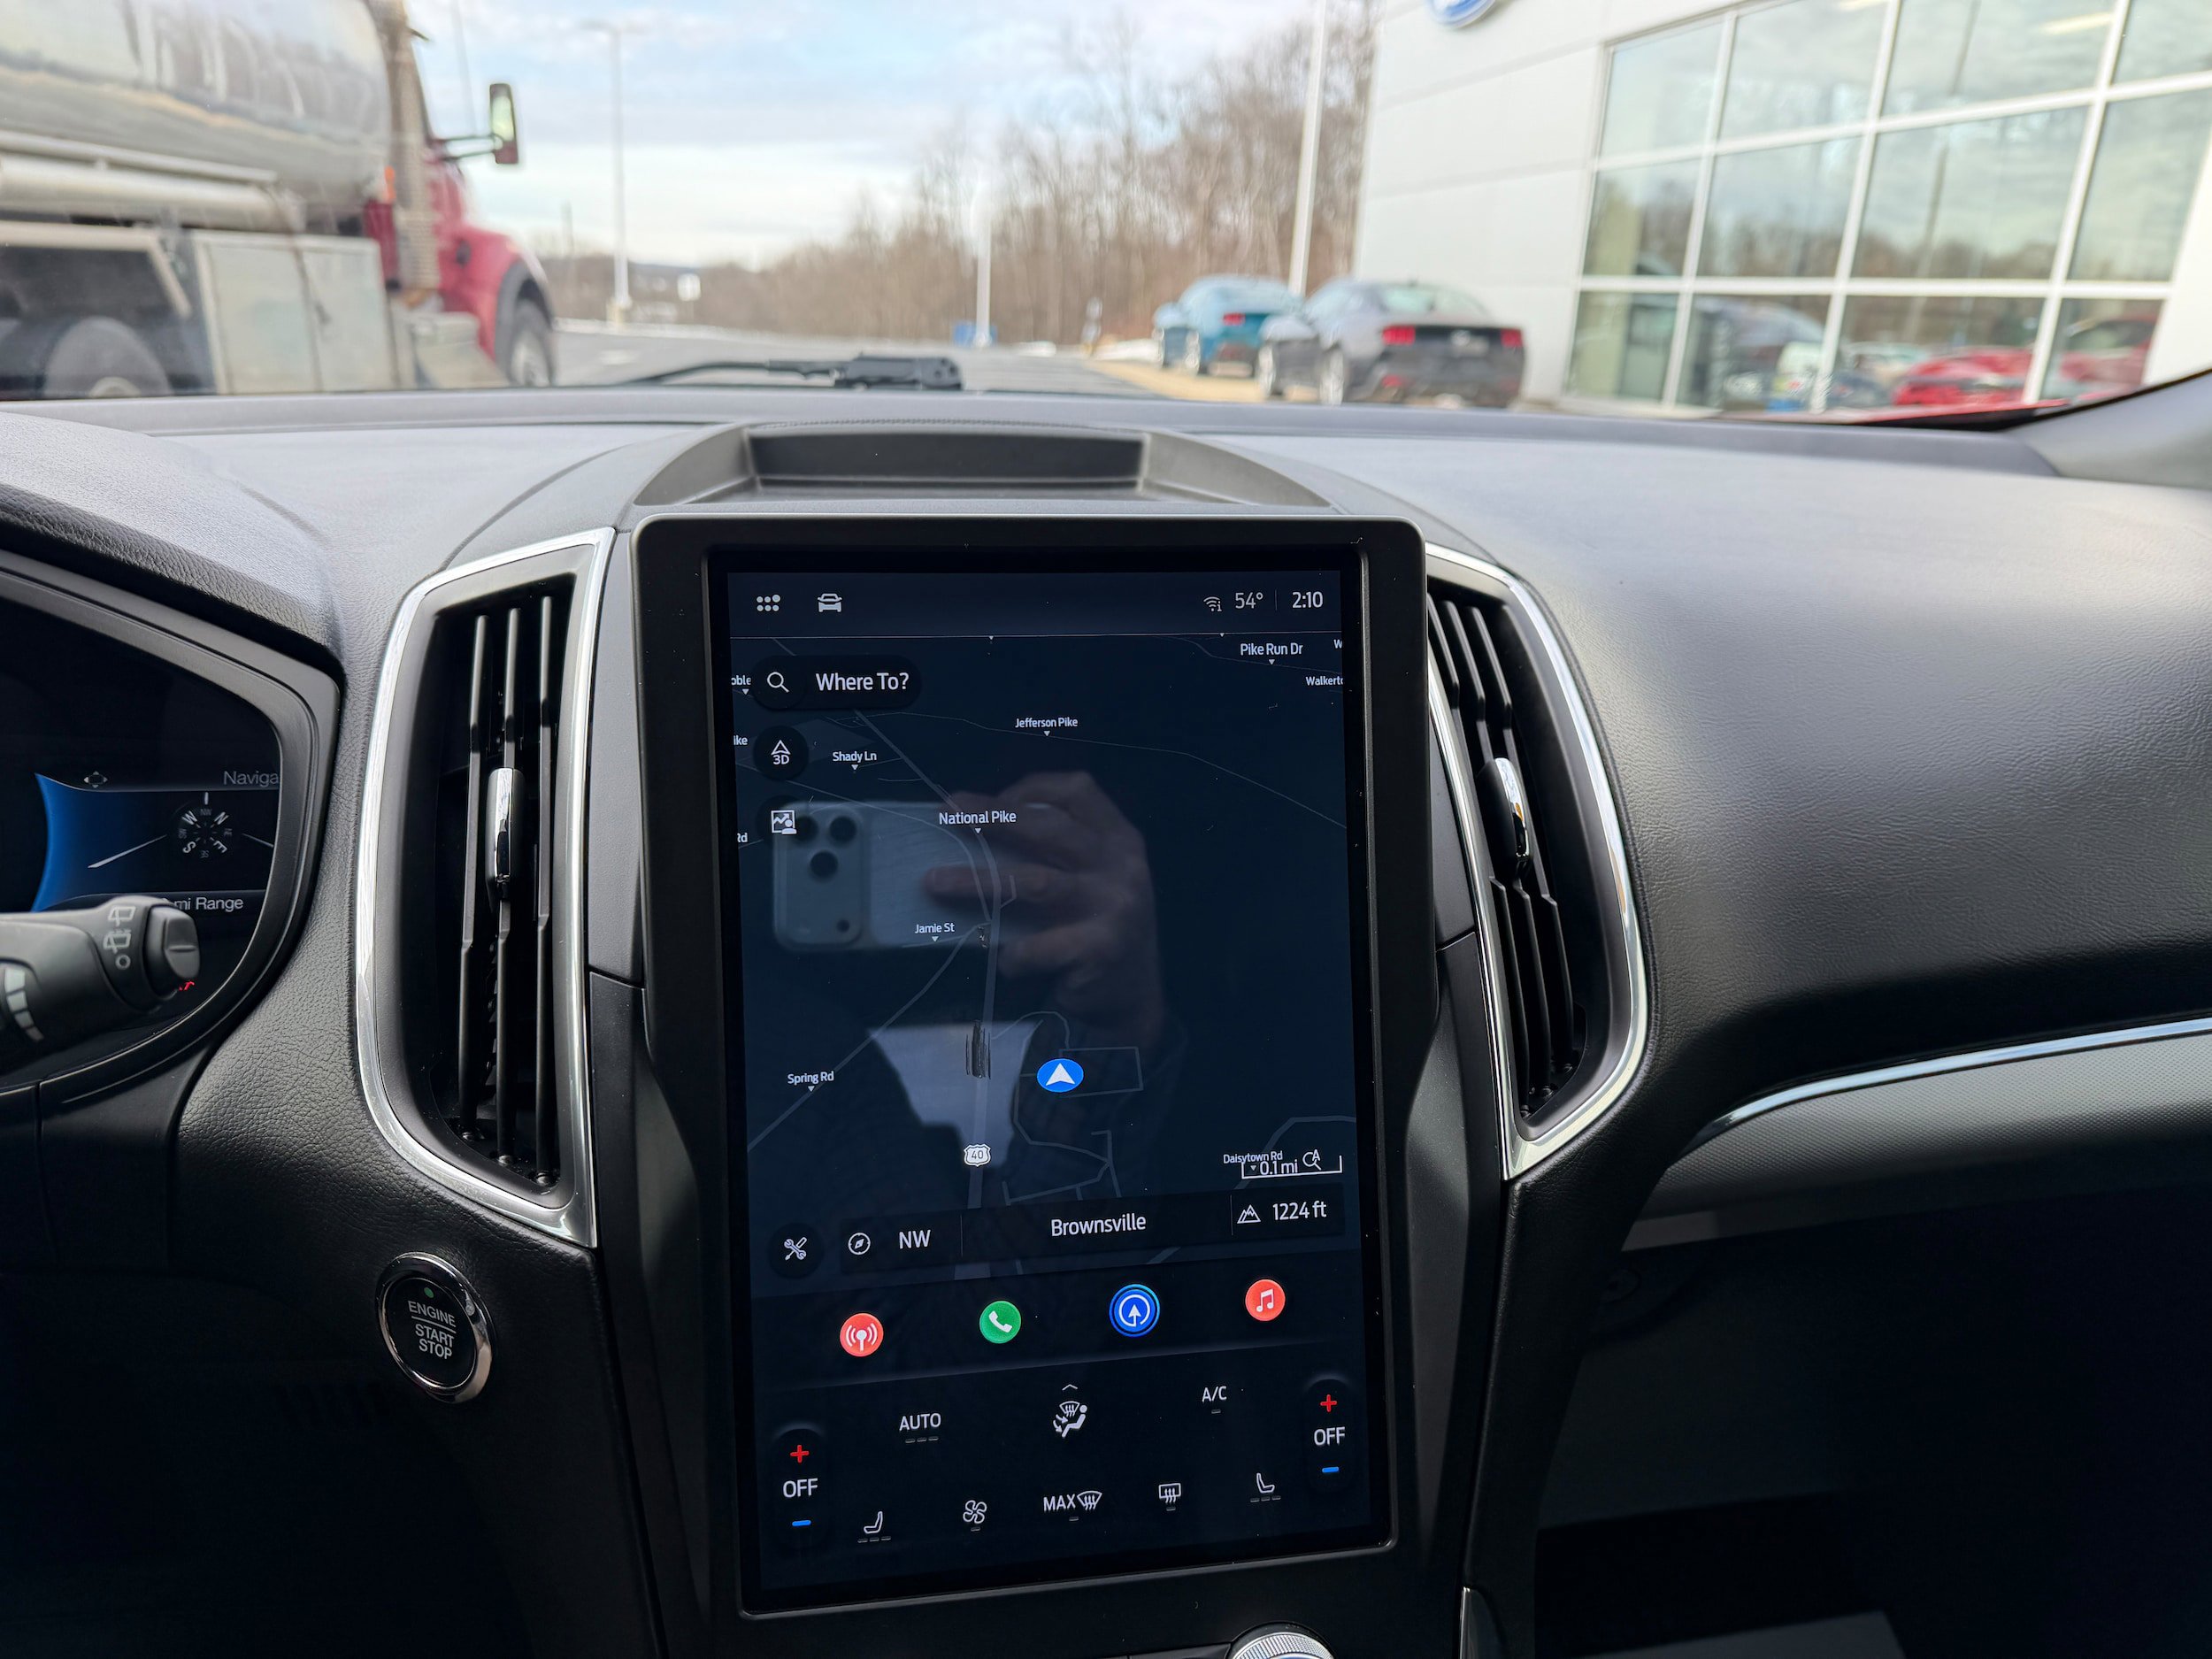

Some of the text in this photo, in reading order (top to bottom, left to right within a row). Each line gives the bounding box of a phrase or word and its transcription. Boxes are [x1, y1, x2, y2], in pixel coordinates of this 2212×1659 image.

[1234, 591, 1264, 610] 54°
[1291, 590, 1324, 609] 2:10
[1240, 642, 1303, 656] Pike Run Dr
[815, 672, 910, 691] Where To?
[1015, 717, 1079, 728] Jefferson Pike
[772, 755, 790, 765] 3D
[832, 751, 877, 764] Shady Ln
[223, 770, 280, 787] Naviga
[939, 810, 1017, 825] National Pike
[196, 896, 244, 912] Range
[915, 922, 955, 934] Jamie St
[787, 1071, 834, 1085] Spring Rd
[971, 1149, 984, 1160] 40
[1223, 1150, 1283, 1164] Daisytown Rd
[1259, 1158, 1299, 1176] 0.1 mi
[1272, 1200, 1327, 1221] 1224 ft
[1050, 1213, 1147, 1237] Brownsville
[898, 1230, 931, 1249] NW
[407, 1300, 457, 1328] ENGINE
[415, 1323, 455, 1348] START
[419, 1338, 453, 1360] STOP
[1202, 1386, 1227, 1402] A/C
[899, 1413, 942, 1432] AUTO
[1313, 1426, 1346, 1447] OFF
[782, 1478, 818, 1499] OFF
[1042, 1493, 1076, 1512] MAX
